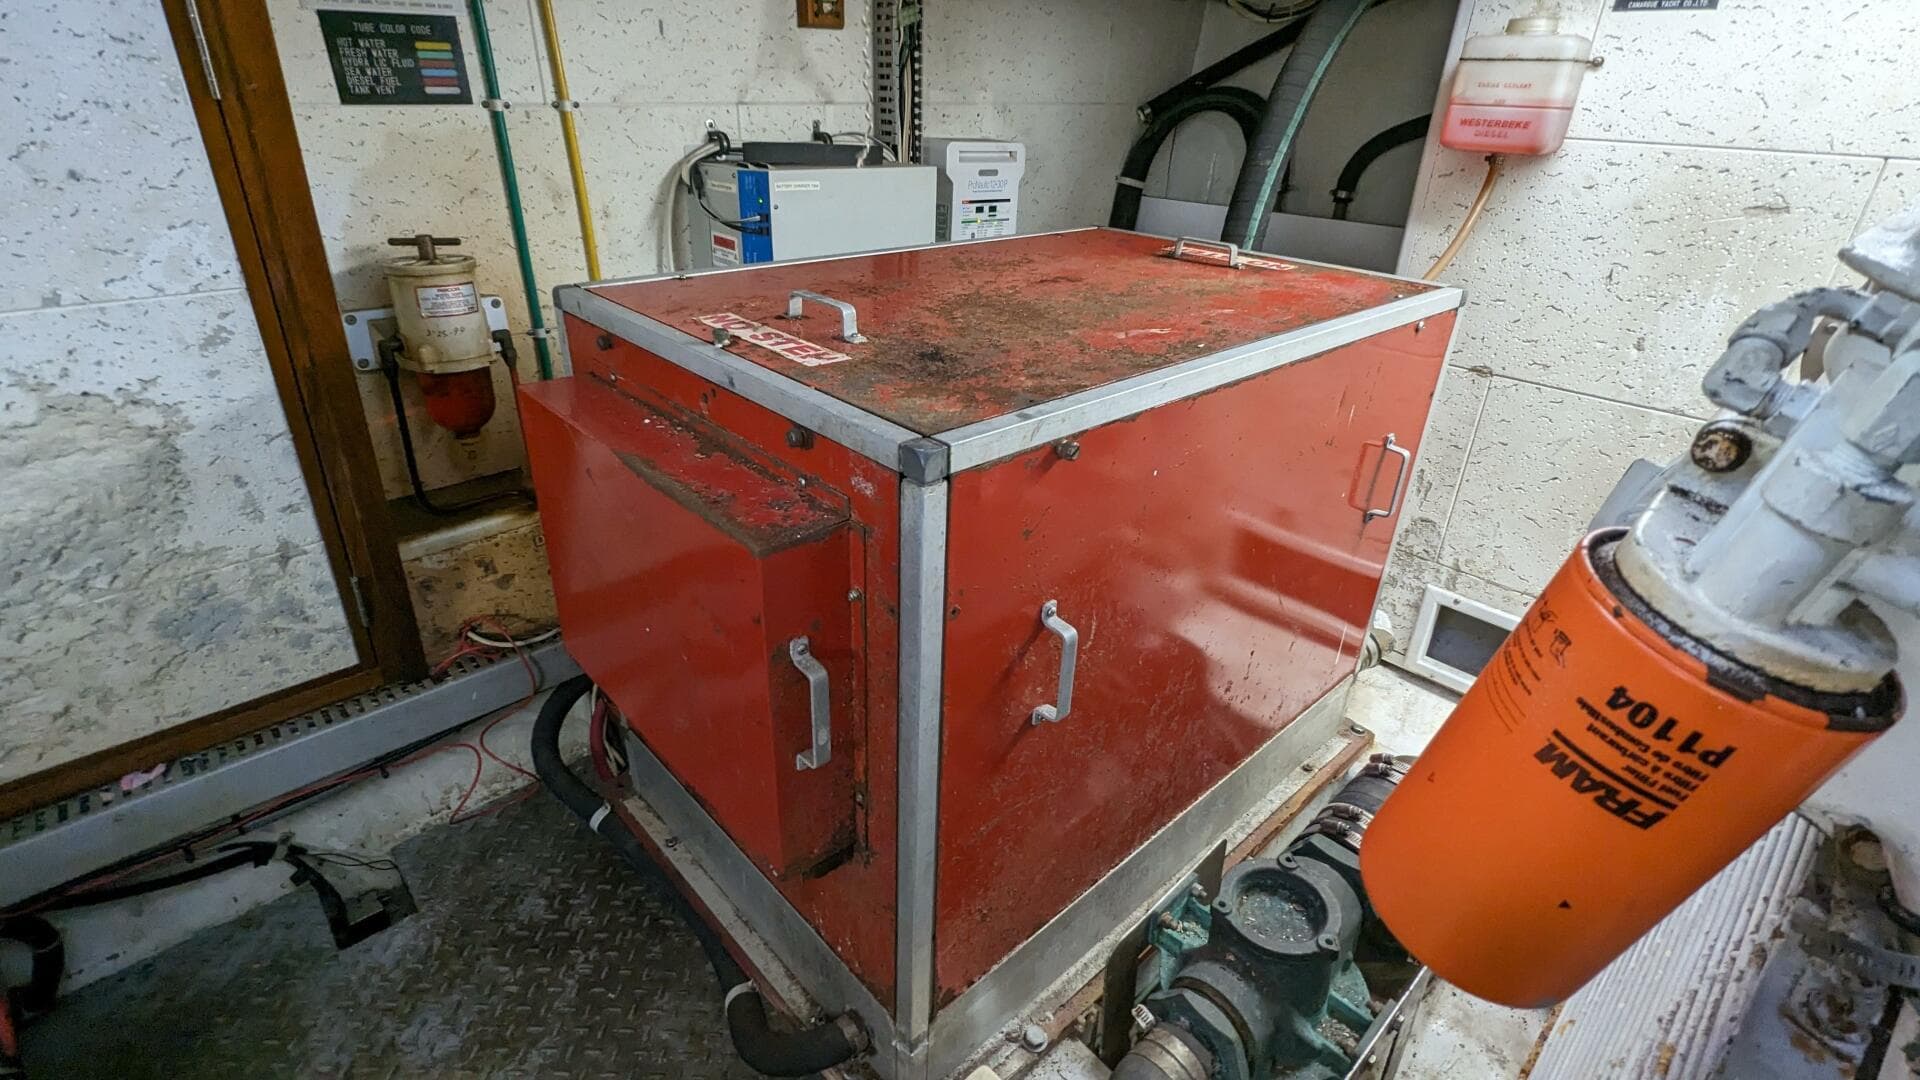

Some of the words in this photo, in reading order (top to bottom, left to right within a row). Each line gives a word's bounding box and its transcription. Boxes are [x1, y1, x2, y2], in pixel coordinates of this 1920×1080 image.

[353, 22, 375, 33] TUBE
[379, 23, 407, 34] COLOR
[410, 24, 432, 35] CODE
[336, 37, 352, 47] HOT
[358, 38, 386, 49] WATER
[339, 48, 367, 58] FRESH
[370, 49, 399, 59] WATER
[391, 58, 415, 68] FLUID
[344, 67, 361, 76] SEA
[365, 67, 392, 77] WATER
[346, 75, 376, 86] DIESEL
[379, 77, 402, 86] FUEL
[349, 85, 371, 95] TANK
[375, 86, 396, 95] VENT
[1459, 118, 1532, 129] WESTERBEKE
[1474, 130, 1509, 139] DIESEL
[1576, 697, 1651, 753] Combustible
[1605, 685, 1738, 769] P1104
[1586, 723, 1650, 767] carburant
[1652, 750, 1671, 763] de
[1621, 763, 1659, 789] Filter
[1533, 741, 1667, 830] FRAM
[1659, 781, 1690, 802] Fuel
